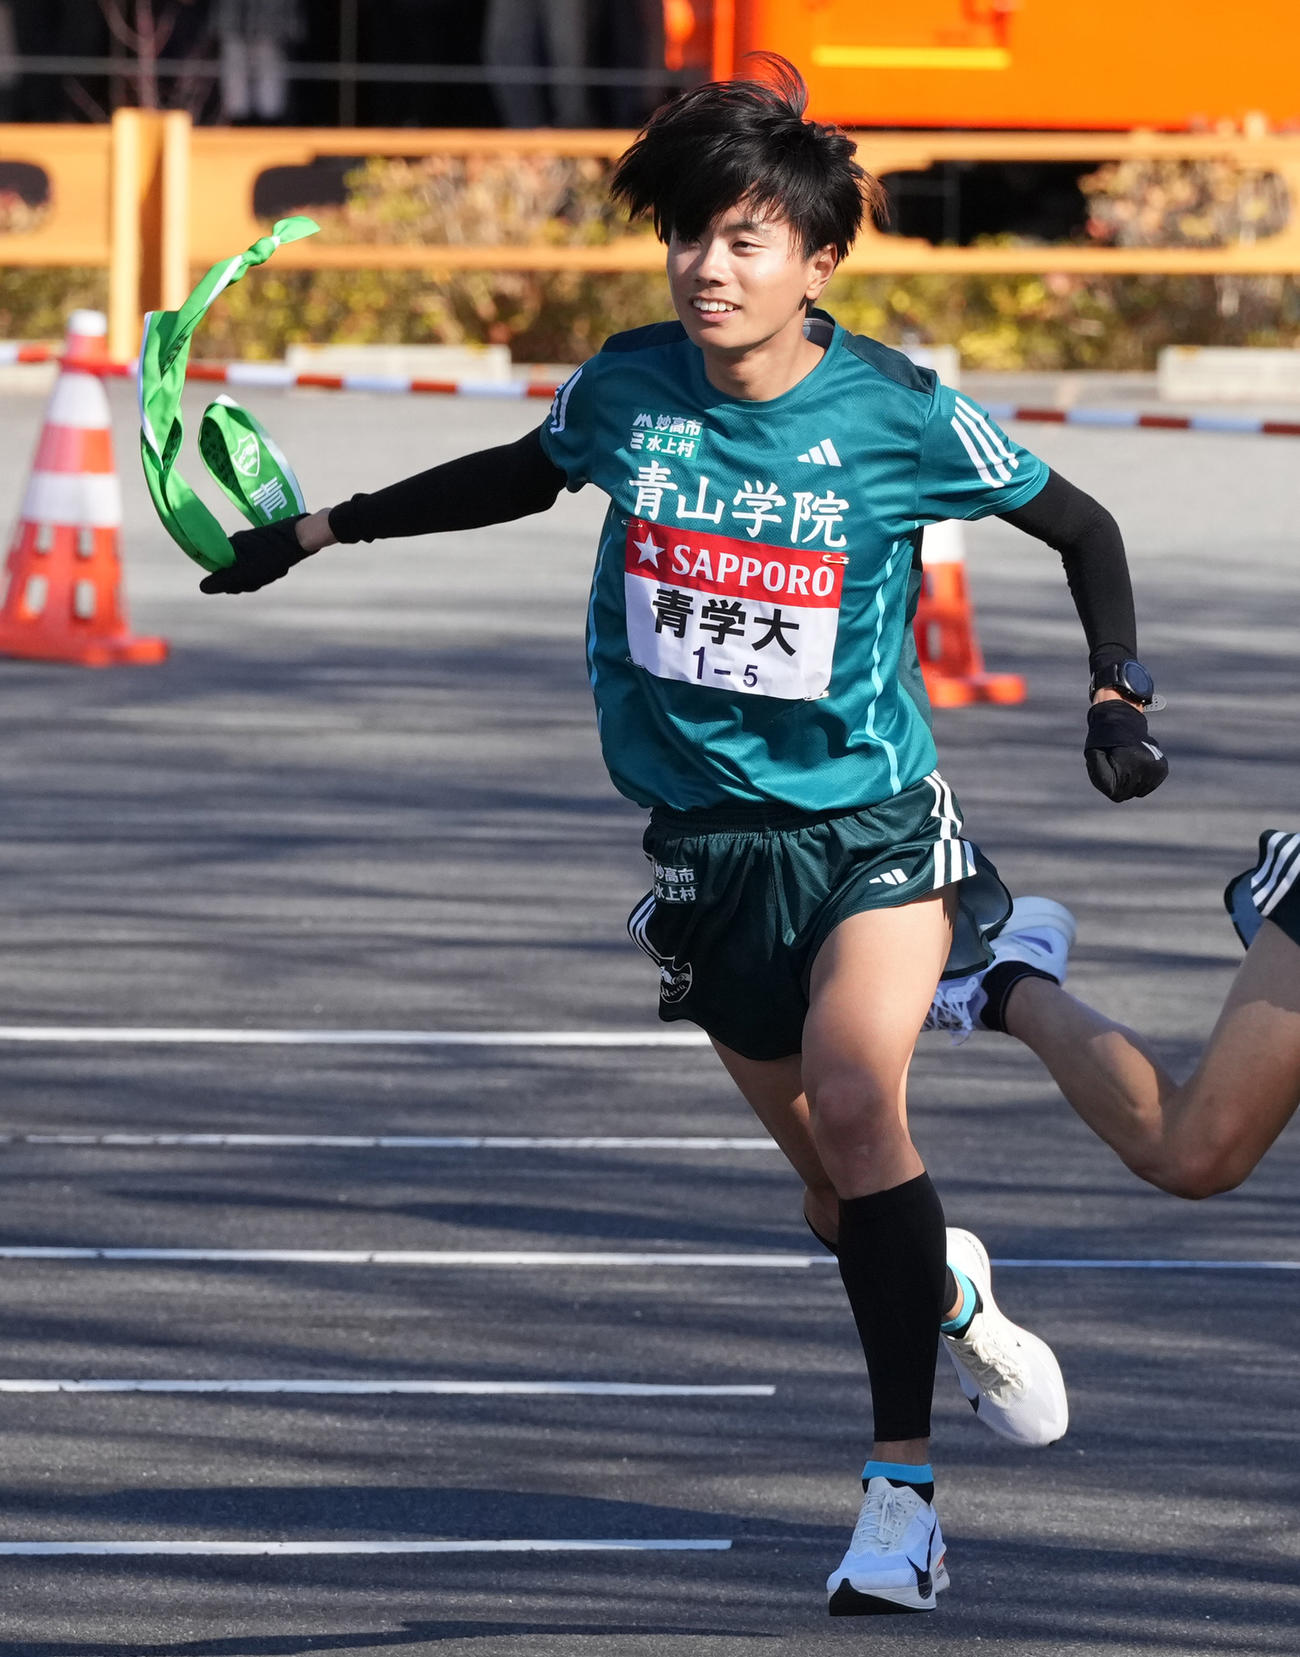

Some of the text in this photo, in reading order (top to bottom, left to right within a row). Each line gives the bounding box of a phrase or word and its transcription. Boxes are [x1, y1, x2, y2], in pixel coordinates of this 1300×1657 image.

[646, 434, 695, 458] 水上村
[655, 414, 703, 436] 妙高市
[628, 460, 849, 547] 青山学院
[671, 544, 835, 597] SAPPORO
[652, 588, 799, 657] 青学大
